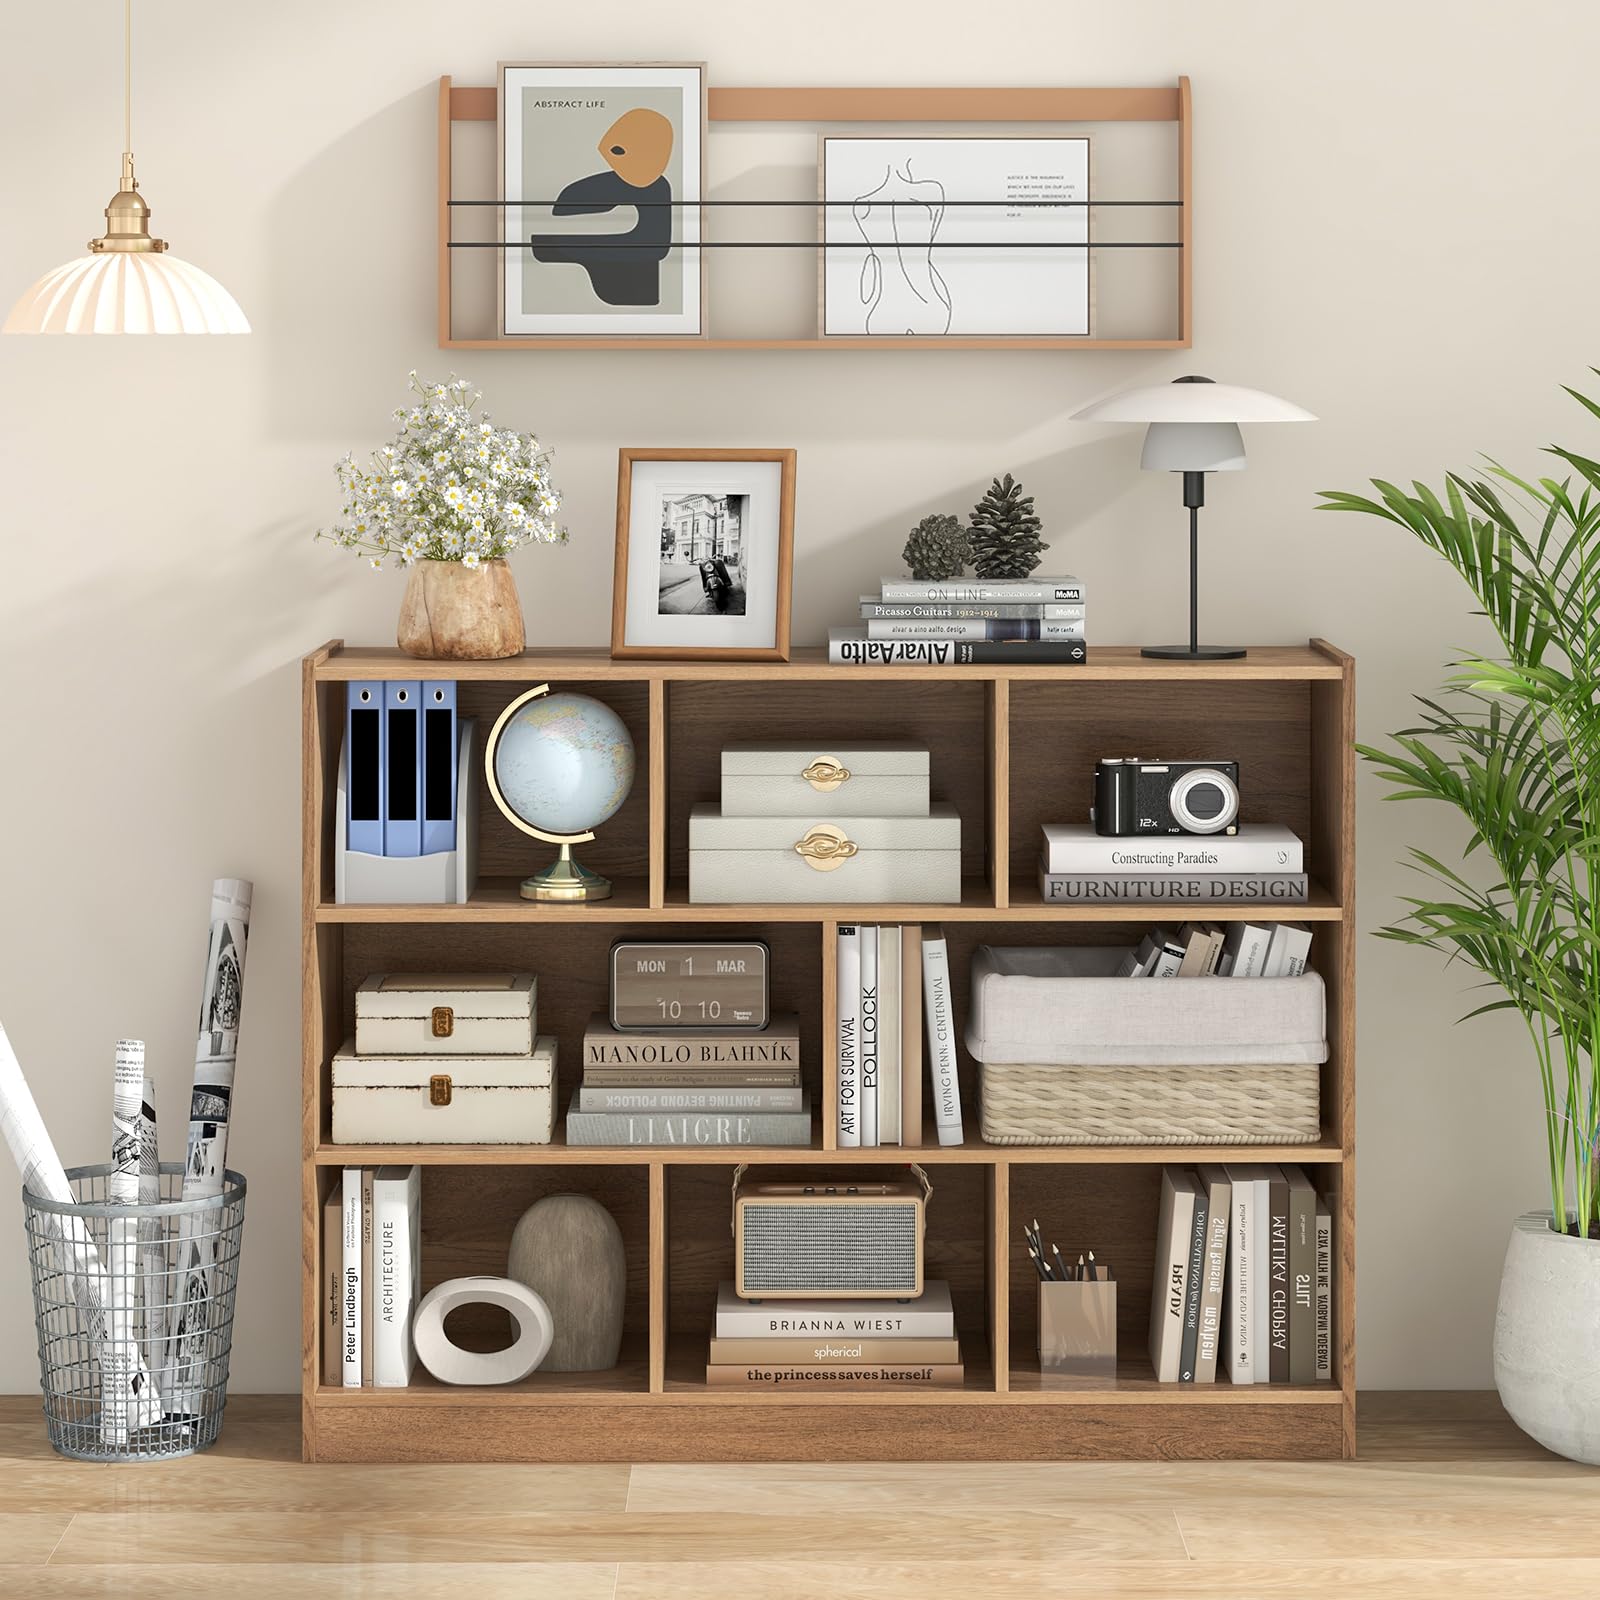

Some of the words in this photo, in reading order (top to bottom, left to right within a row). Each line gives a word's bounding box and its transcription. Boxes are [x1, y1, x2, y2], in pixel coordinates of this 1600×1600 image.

[533, 100, 582, 108] ABSTRACT
[586, 100, 606, 108] LIFE
[927, 588, 952, 601] ON
[955, 588, 988, 601] LINE
[1056, 590, 1079, 599] MoMA
[875, 606, 911, 617] Picasso
[913, 606, 952, 617] Guitars
[1055, 608, 1081, 617] MoMA
[1139, 818, 1158, 828] 12x
[1111, 851, 1174, 866] Constructing
[1177, 851, 1218, 864] Paradies
[1050, 880, 1201, 898] FURNITURE
[1210, 880, 1305, 898] DESIGN
[637, 960, 666, 973] MON
[685, 957, 693, 976] 1
[717, 960, 746, 973] MAR
[658, 1000, 681, 1019] 10
[698, 1000, 721, 1019] 10
[933, 976, 948, 1042] CENTENNIAL
[862, 986, 877, 1088] POLLOCK
[590, 1045, 691, 1063] MANOLO
[700, 1041, 793, 1062] BLAHNÍK
[840, 1017, 855, 1077] SURVIVAL
[939, 1043, 950, 1074] PENN:
[606, 1095, 658, 1108] POLLOCK
[661, 1095, 706, 1108] BEYOND
[708, 1095, 761, 1108] PAINTING
[840, 1079, 855, 1106] FOR
[941, 1076, 954, 1117] IRVING
[628, 1117, 751, 1144] LIAIGRE
[840, 1111, 855, 1134] ART
[383, 1221, 394, 1323] ARCHITECTURE
[345, 1267, 359, 1328] Lindbergh
[770, 1320, 845, 1331] BRIANNA
[854, 1320, 903, 1331] WIEST
[345, 1332, 356, 1363] Peter
[814, 1345, 862, 1360] spherical
[747, 1369, 772, 1381] the
[774, 1369, 837, 1383] princess
[838, 1371, 879, 1381] saves
[880, 1369, 933, 1381] herself
